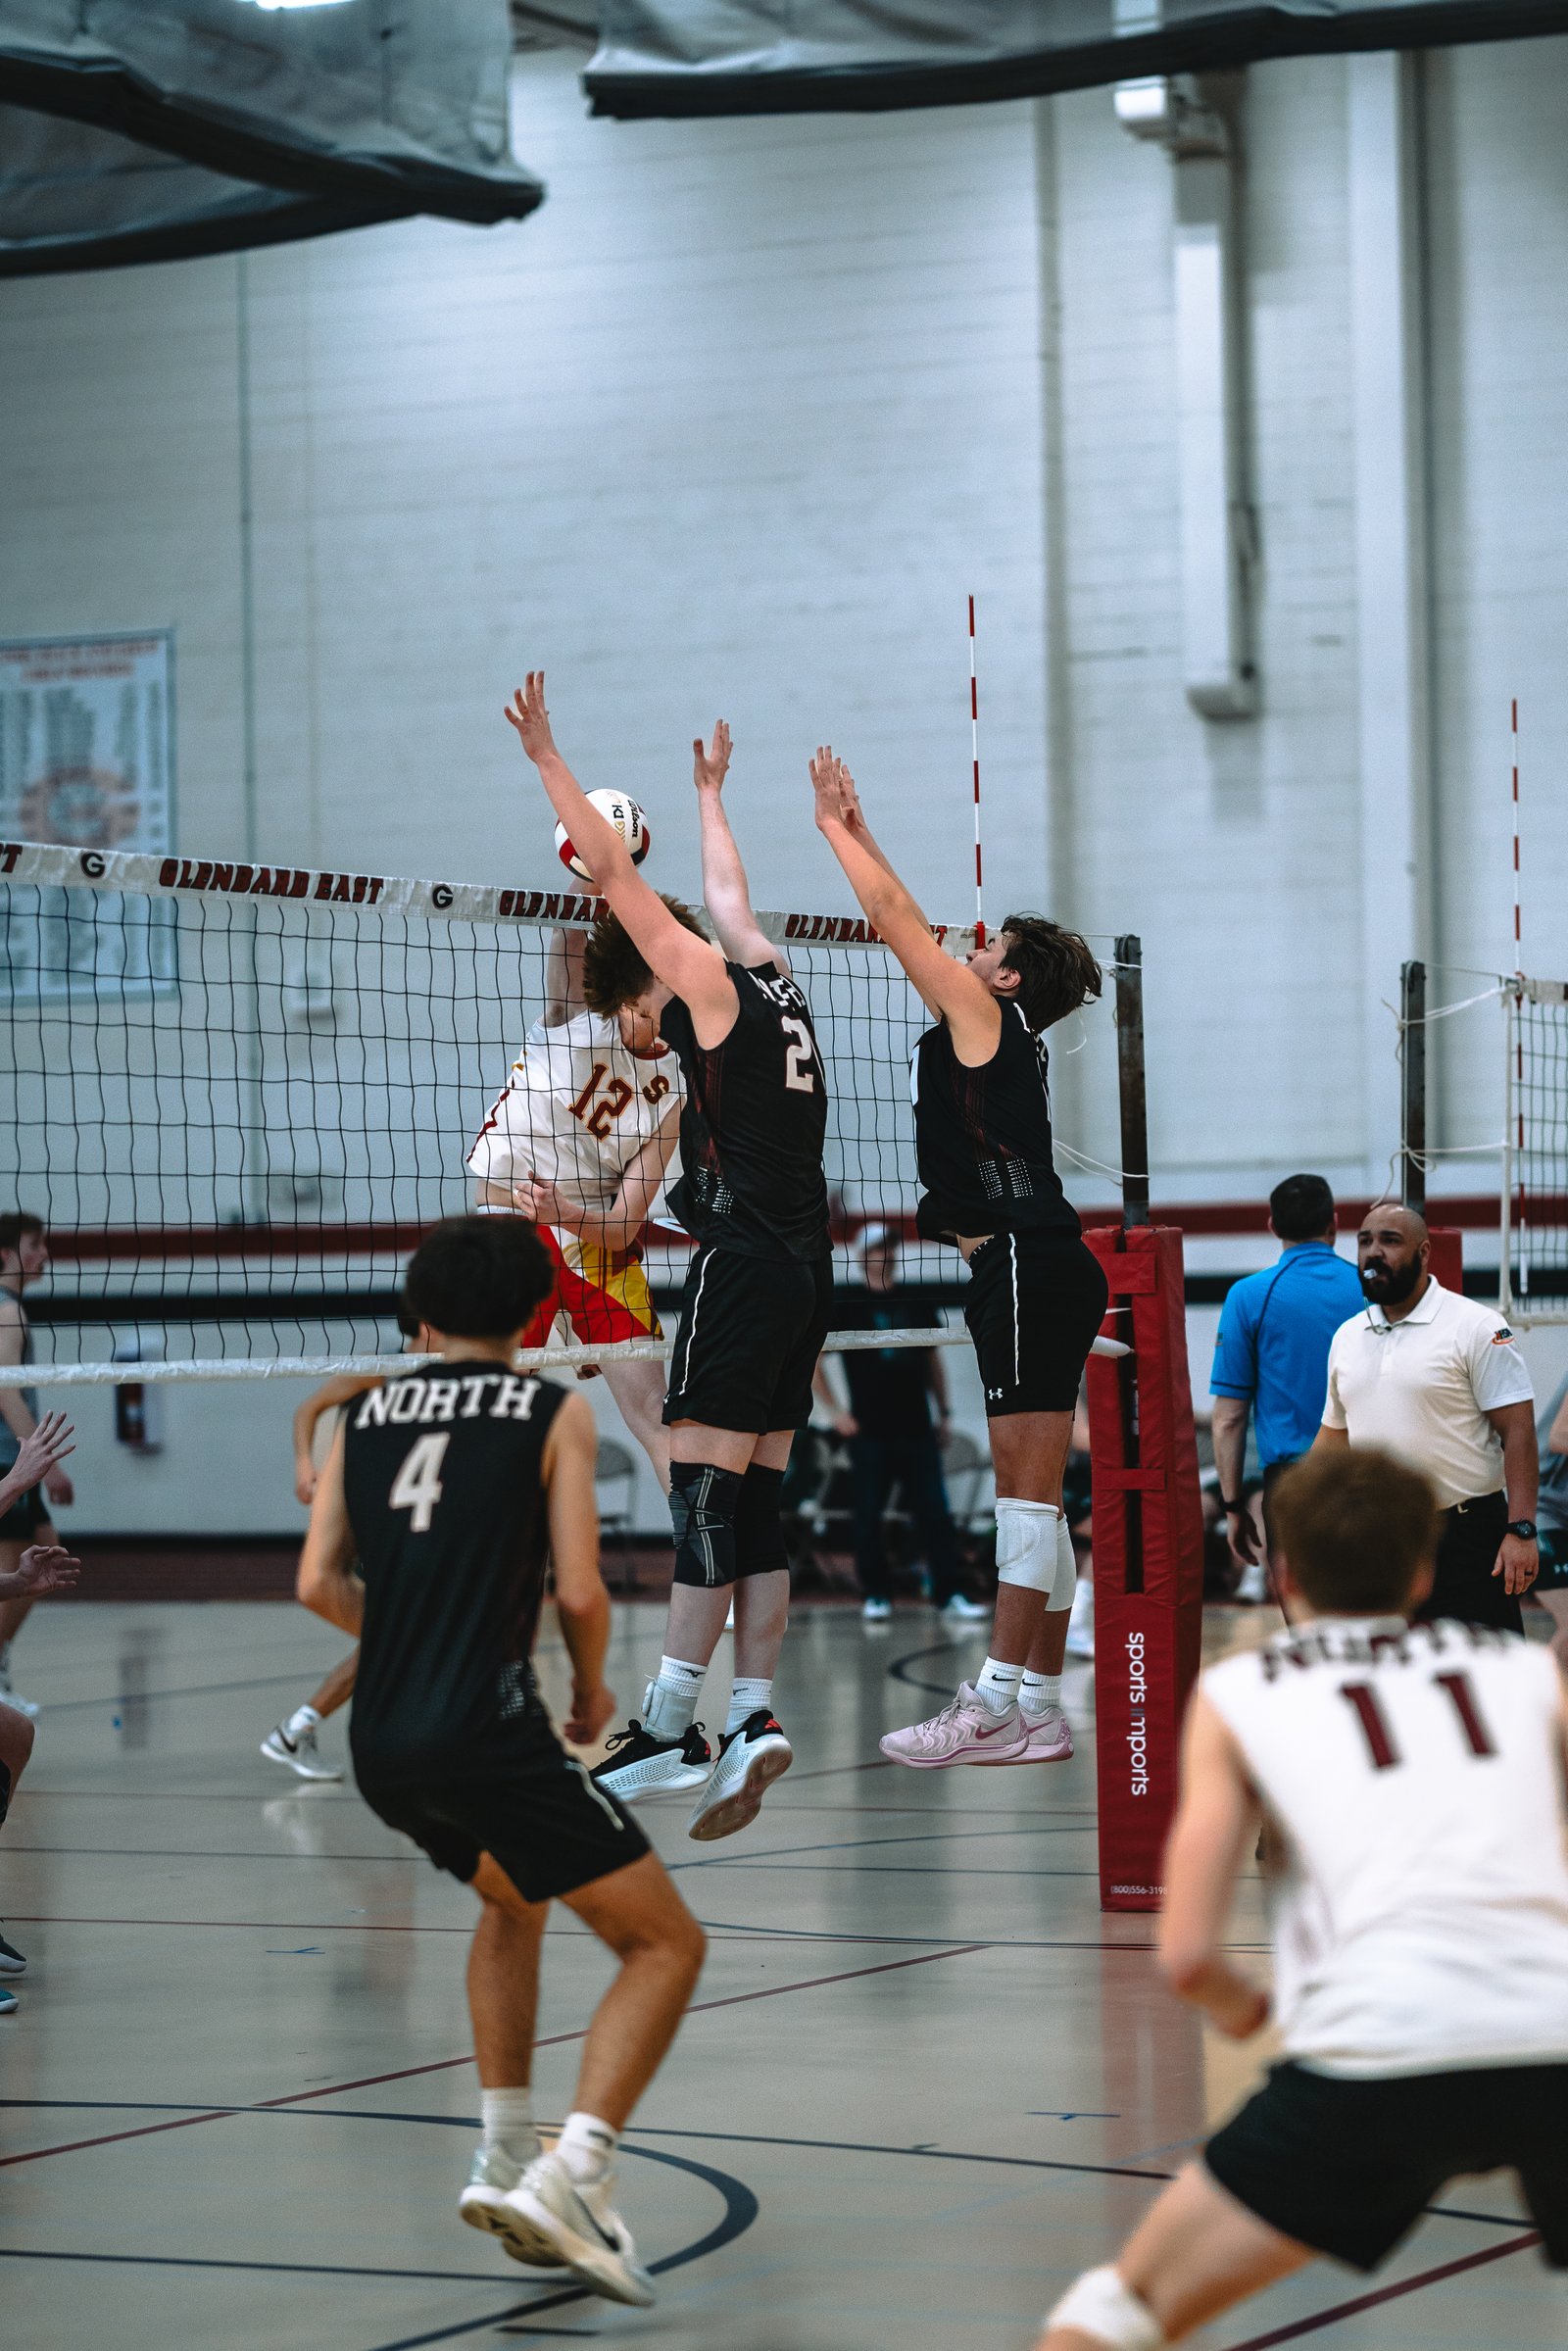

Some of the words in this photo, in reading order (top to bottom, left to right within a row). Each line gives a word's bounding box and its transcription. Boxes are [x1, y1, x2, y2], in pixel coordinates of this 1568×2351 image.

[80, 852, 106, 878] G
[159, 857, 310, 899] GLENBARD
[314, 872, 384, 905] EAST
[431, 884, 455, 911] G
[499, 890, 610, 923] GLENBAR
[780, 1015, 814, 1094] 2
[567, 1062, 635, 1142] 12
[354, 1374, 542, 1429] NORTH
[388, 1432, 451, 1533] 4
[1125, 1632, 1148, 1704] sports
[1338, 1669, 1497, 1771] 11
